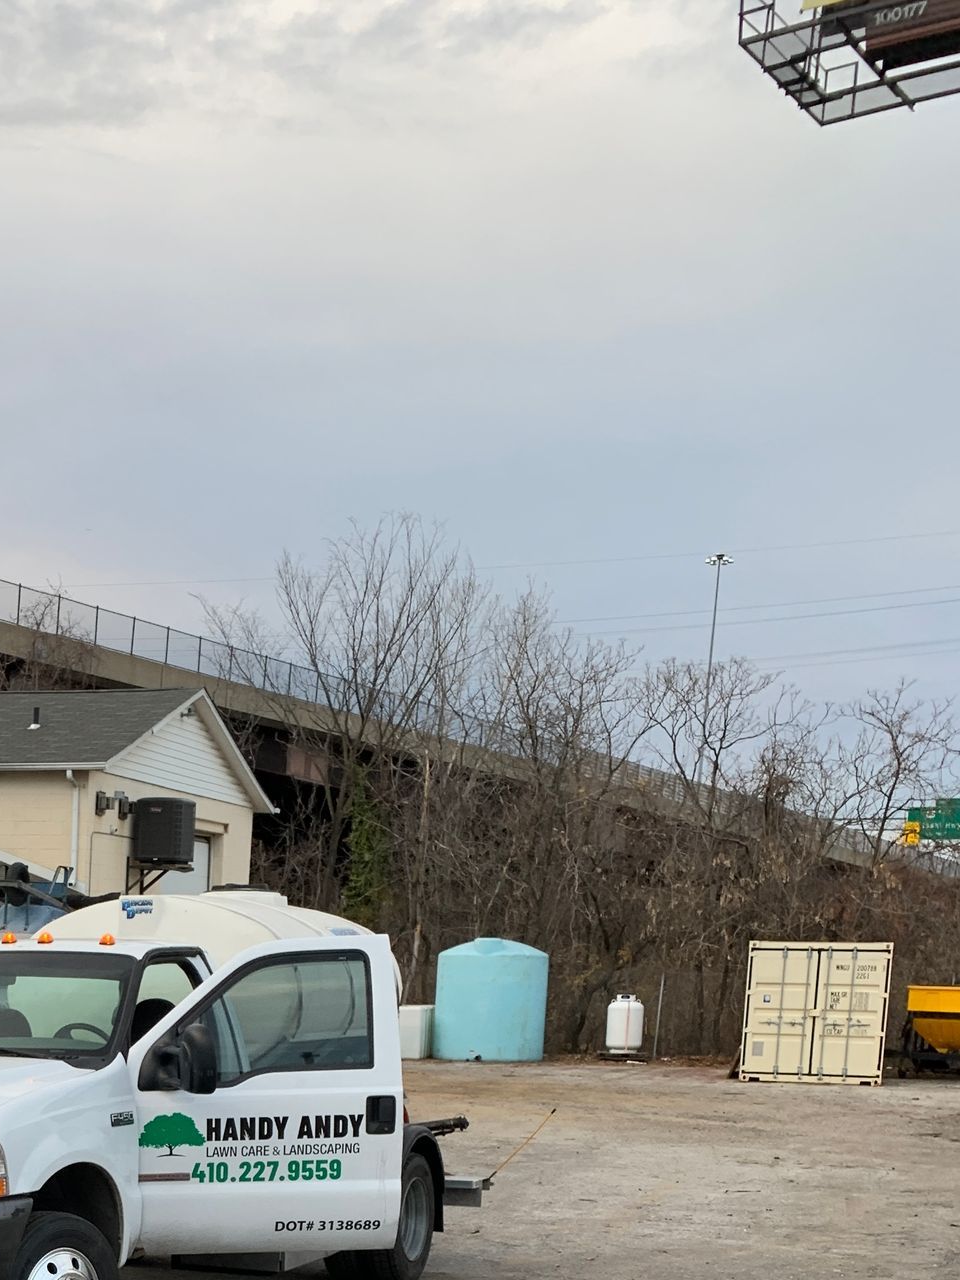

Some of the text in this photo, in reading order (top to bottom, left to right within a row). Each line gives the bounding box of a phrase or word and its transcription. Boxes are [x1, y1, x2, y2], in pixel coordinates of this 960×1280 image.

[874, 1, 927, 26] 100177
[206, 1114, 364, 1141] HANDY ANDY
[206, 1143, 360, 1157] LAWN CARE & LANDSCAPING
[191, 1159, 342, 1183] 410.227.9559
[275, 1219, 381, 1232] DOT# 3138689
